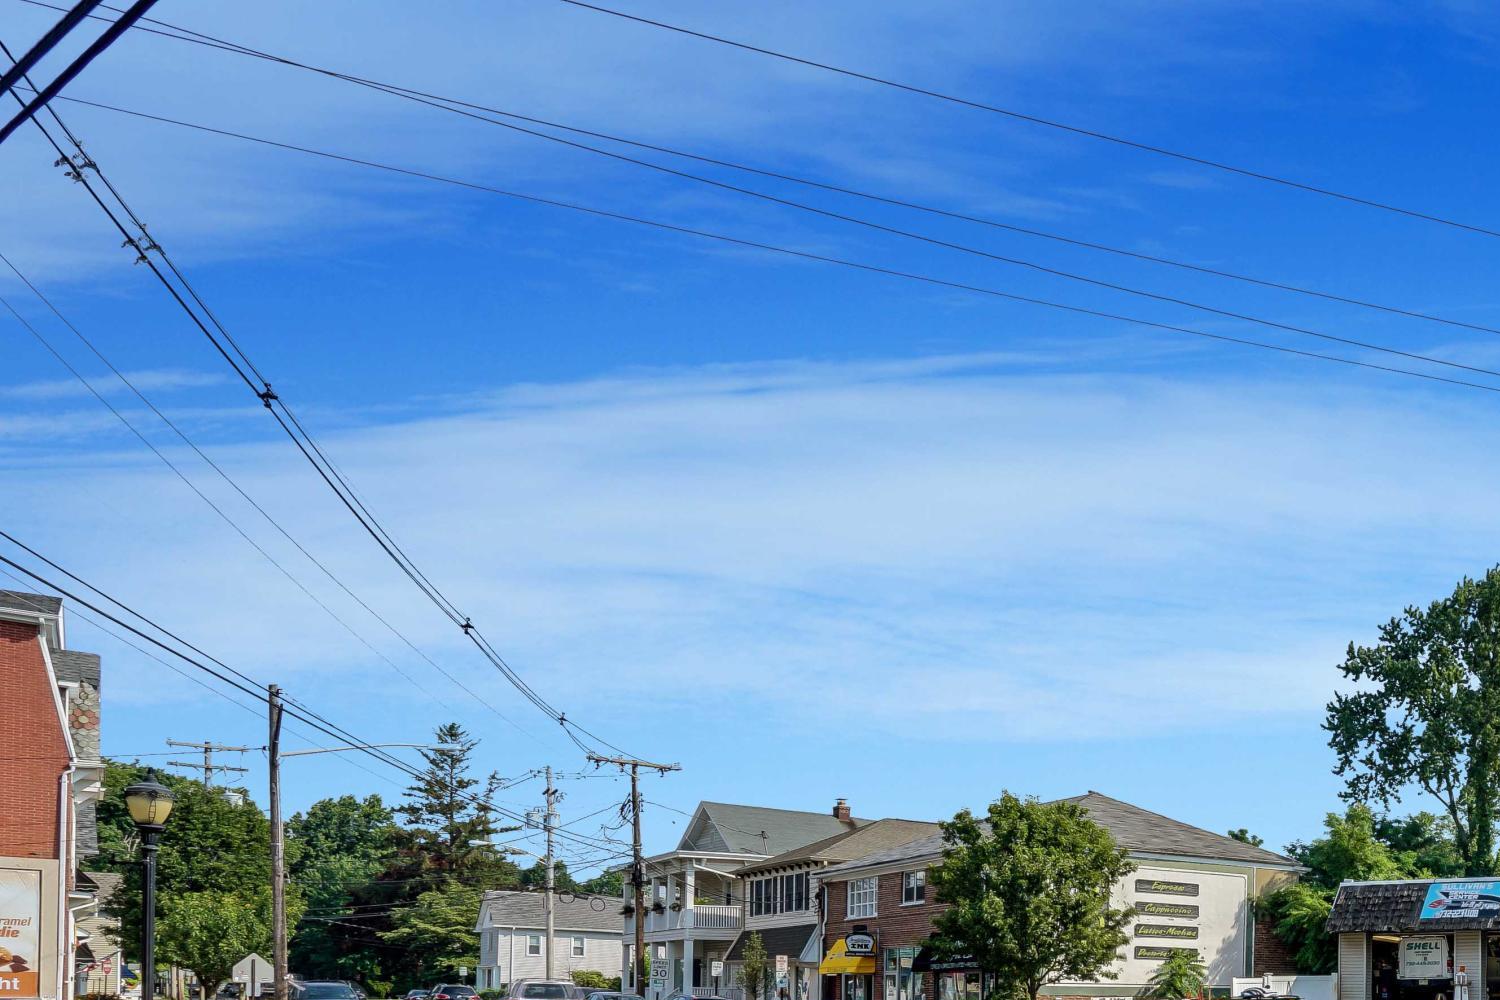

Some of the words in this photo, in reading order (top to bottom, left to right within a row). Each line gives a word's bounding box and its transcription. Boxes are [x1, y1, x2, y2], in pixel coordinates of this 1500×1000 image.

[1441, 882, 1494, 890] SULLIVAN'S
[1406, 942, 1441, 950] SHELL
[652, 969, 667, 977] 30
